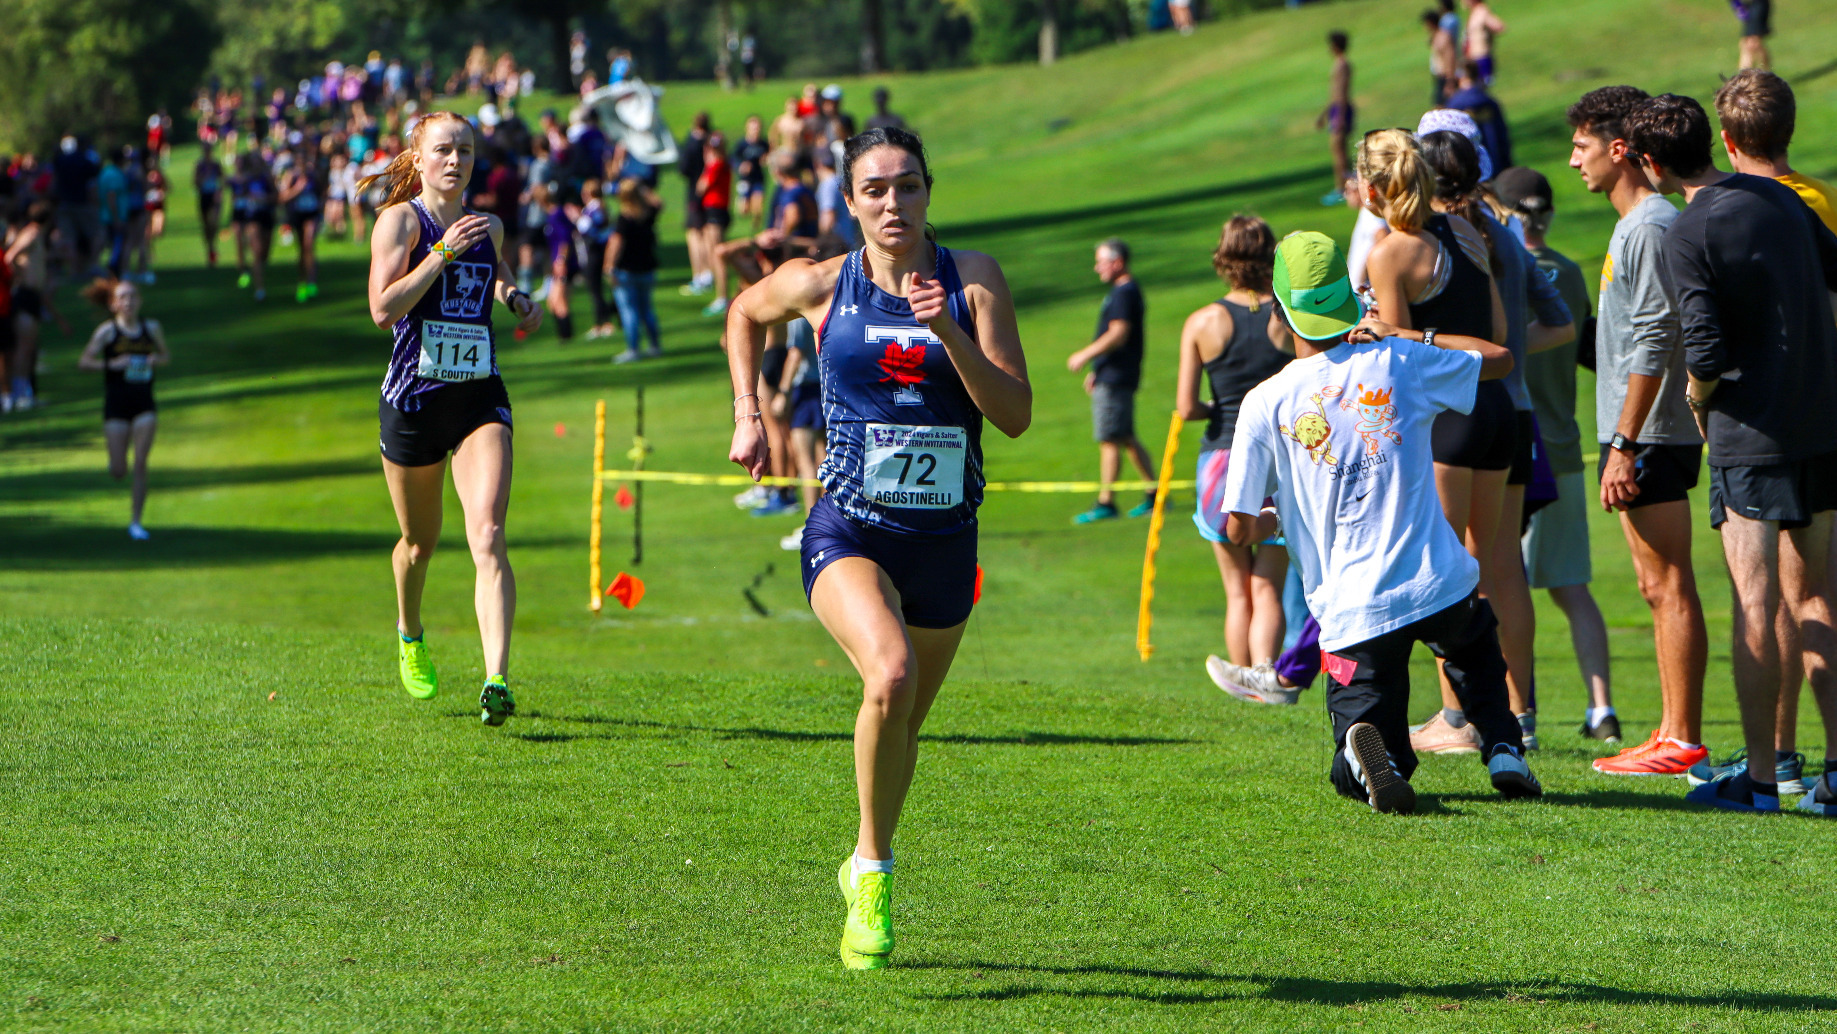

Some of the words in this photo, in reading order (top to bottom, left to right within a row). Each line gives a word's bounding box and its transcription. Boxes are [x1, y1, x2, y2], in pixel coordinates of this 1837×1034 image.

[443, 332, 462, 340] WESTERN
[435, 341, 479, 367] 114
[432, 368, 439, 378] S
[441, 369, 475, 380] COUTTS
[901, 430, 916, 438] 2024
[941, 431, 958, 439] Salter
[895, 438, 923, 448] WESTERN
[924, 440, 962, 449] INVITATIONAL
[893, 452, 937, 485] 72
[875, 490, 951, 505] AGOSTINELLI
